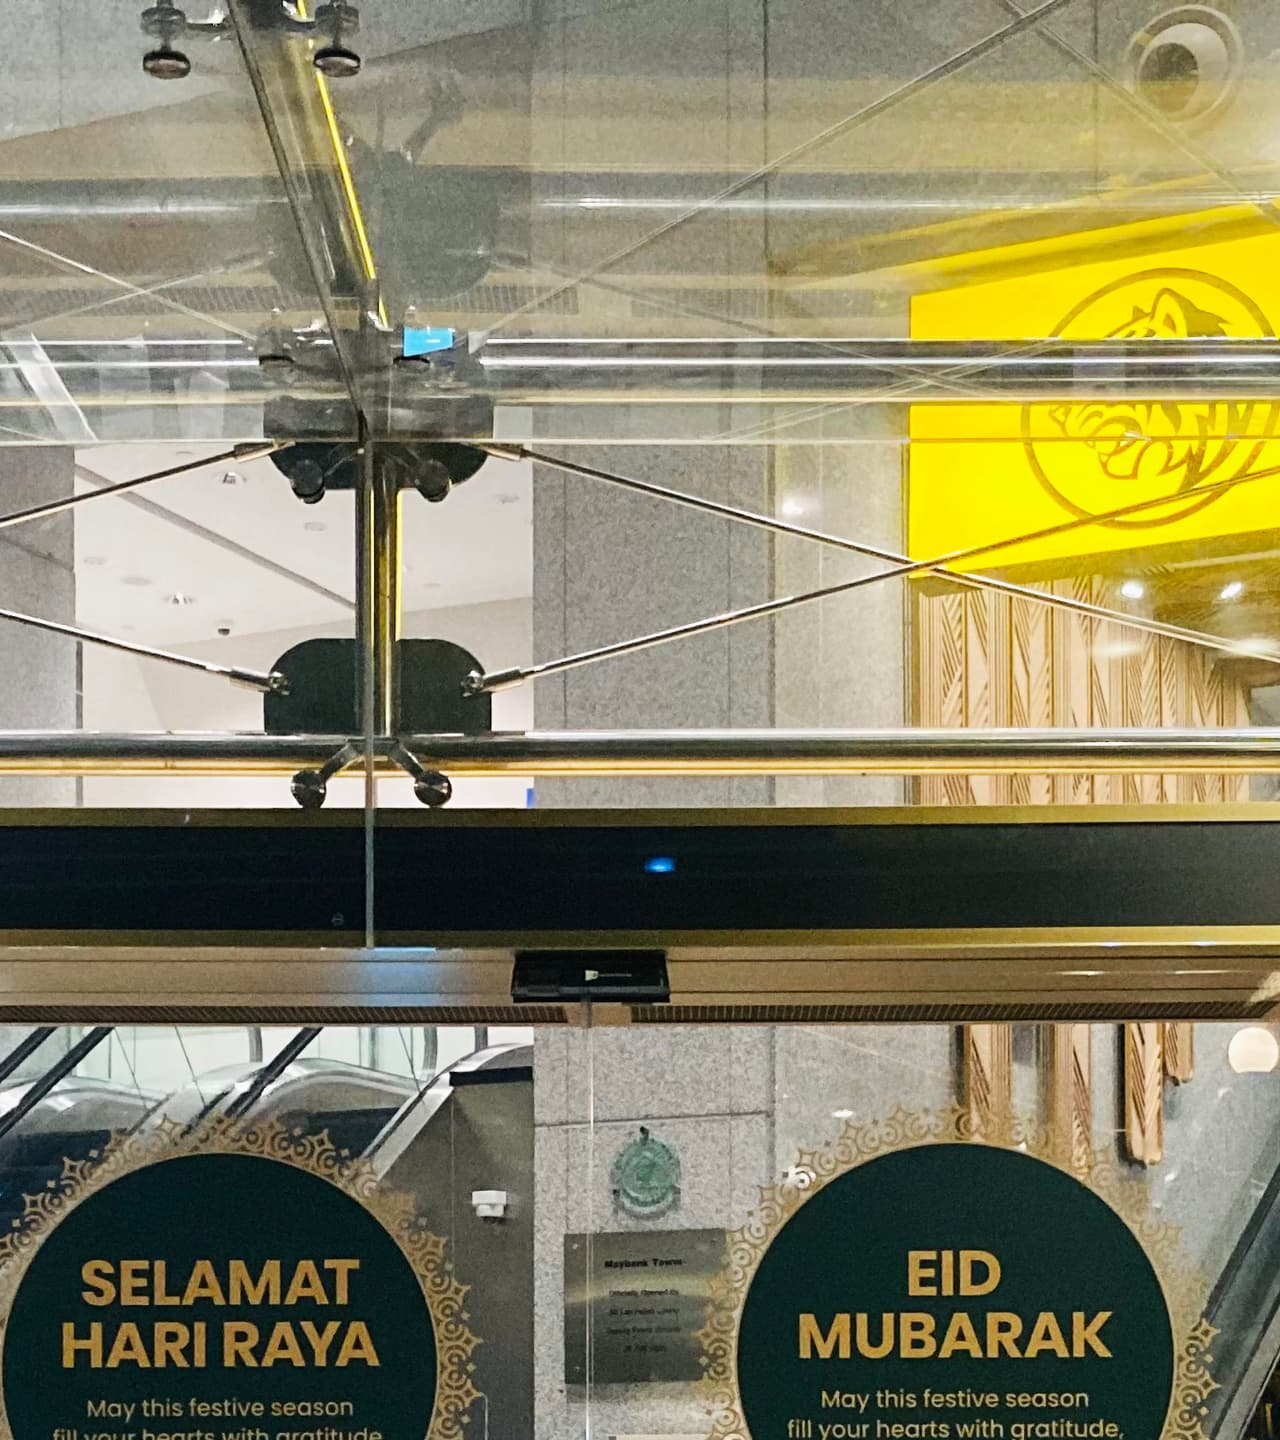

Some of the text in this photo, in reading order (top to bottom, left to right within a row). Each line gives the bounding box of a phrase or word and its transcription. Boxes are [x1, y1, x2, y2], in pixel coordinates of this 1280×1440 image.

[81, 1258, 360, 1306] SELAMAT
[908, 1249, 1002, 1297] EID
[62, 1320, 380, 1369] HARI RAYA
[799, 1311, 1113, 1359] MUBARAK
[87, 1397, 353, 1423] May this festive season
[821, 1388, 1089, 1414] May this festive season
[787, 1419, 812, 1439] fill
[876, 1419, 950, 1439] hearts
[955, 1418, 1004, 1438] with
